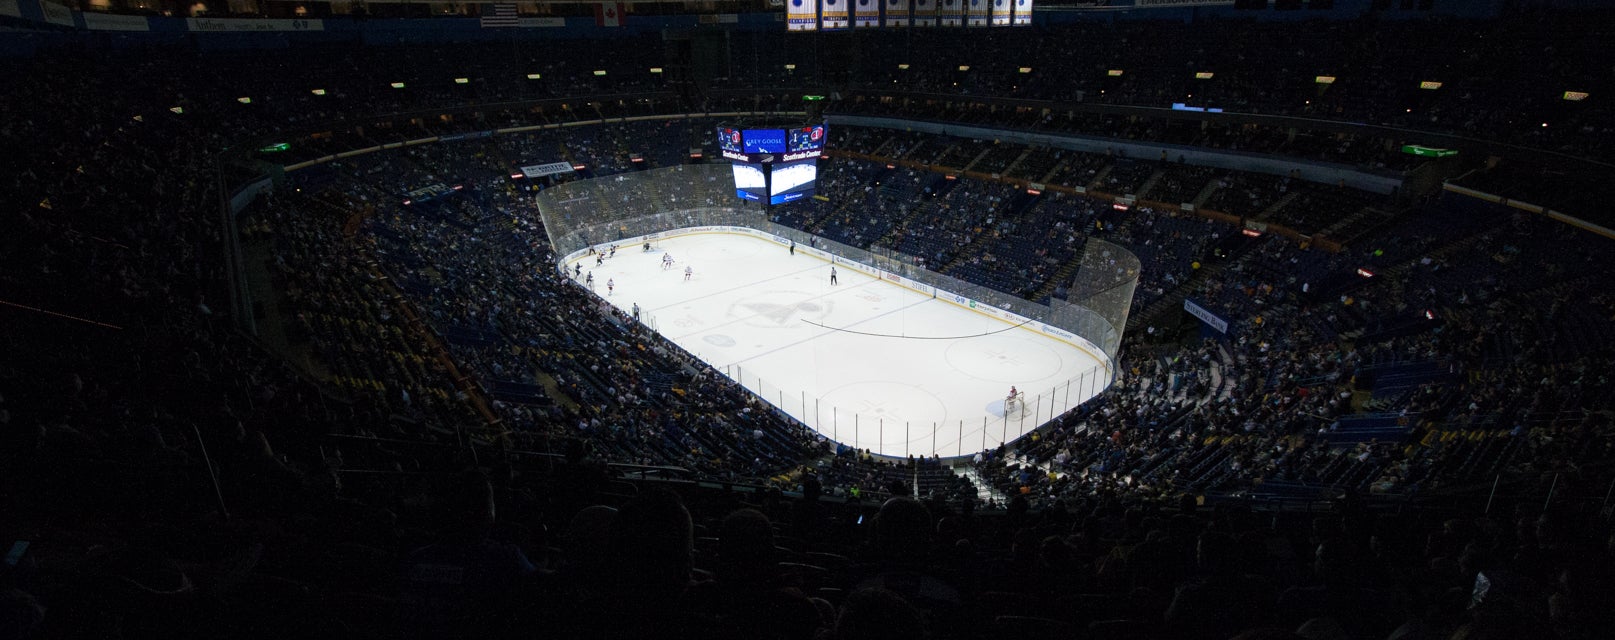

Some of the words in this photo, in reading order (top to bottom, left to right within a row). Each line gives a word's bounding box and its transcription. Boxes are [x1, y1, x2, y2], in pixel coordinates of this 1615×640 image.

[793, 133, 798, 142] 1
[738, 153, 749, 162] Center
[783, 152, 806, 161] Scottrade
[806, 150, 822, 158] Center
[911, 281, 928, 293] STIFEL
